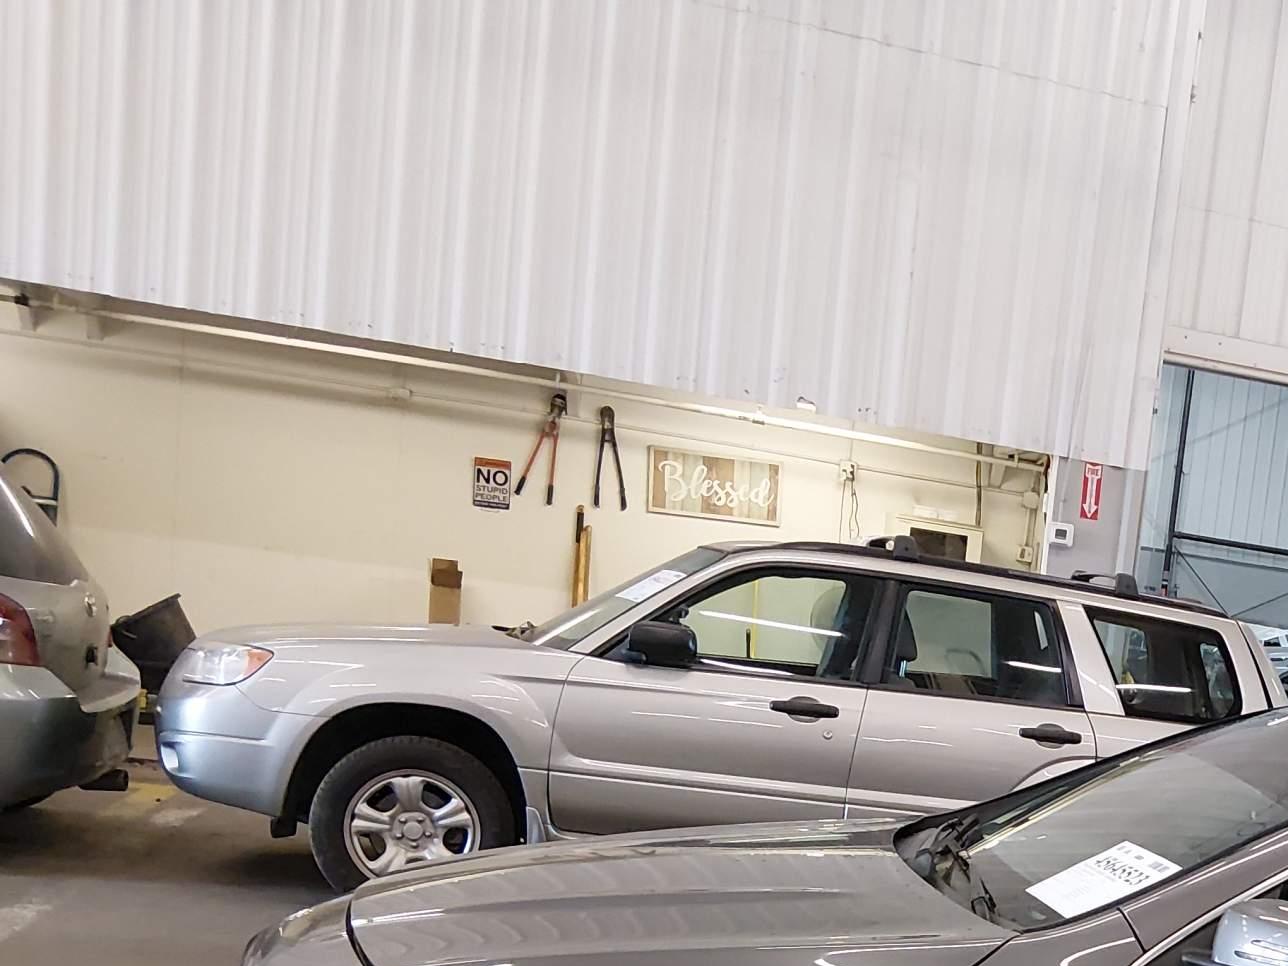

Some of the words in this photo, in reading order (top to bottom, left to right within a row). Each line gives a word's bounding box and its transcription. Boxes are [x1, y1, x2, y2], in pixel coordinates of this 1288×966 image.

[476, 467, 509, 487] NO
[658, 460, 775, 508] Blessed
[475, 484, 509, 495] STUPID
[475, 492, 509, 502] PEOPLE
